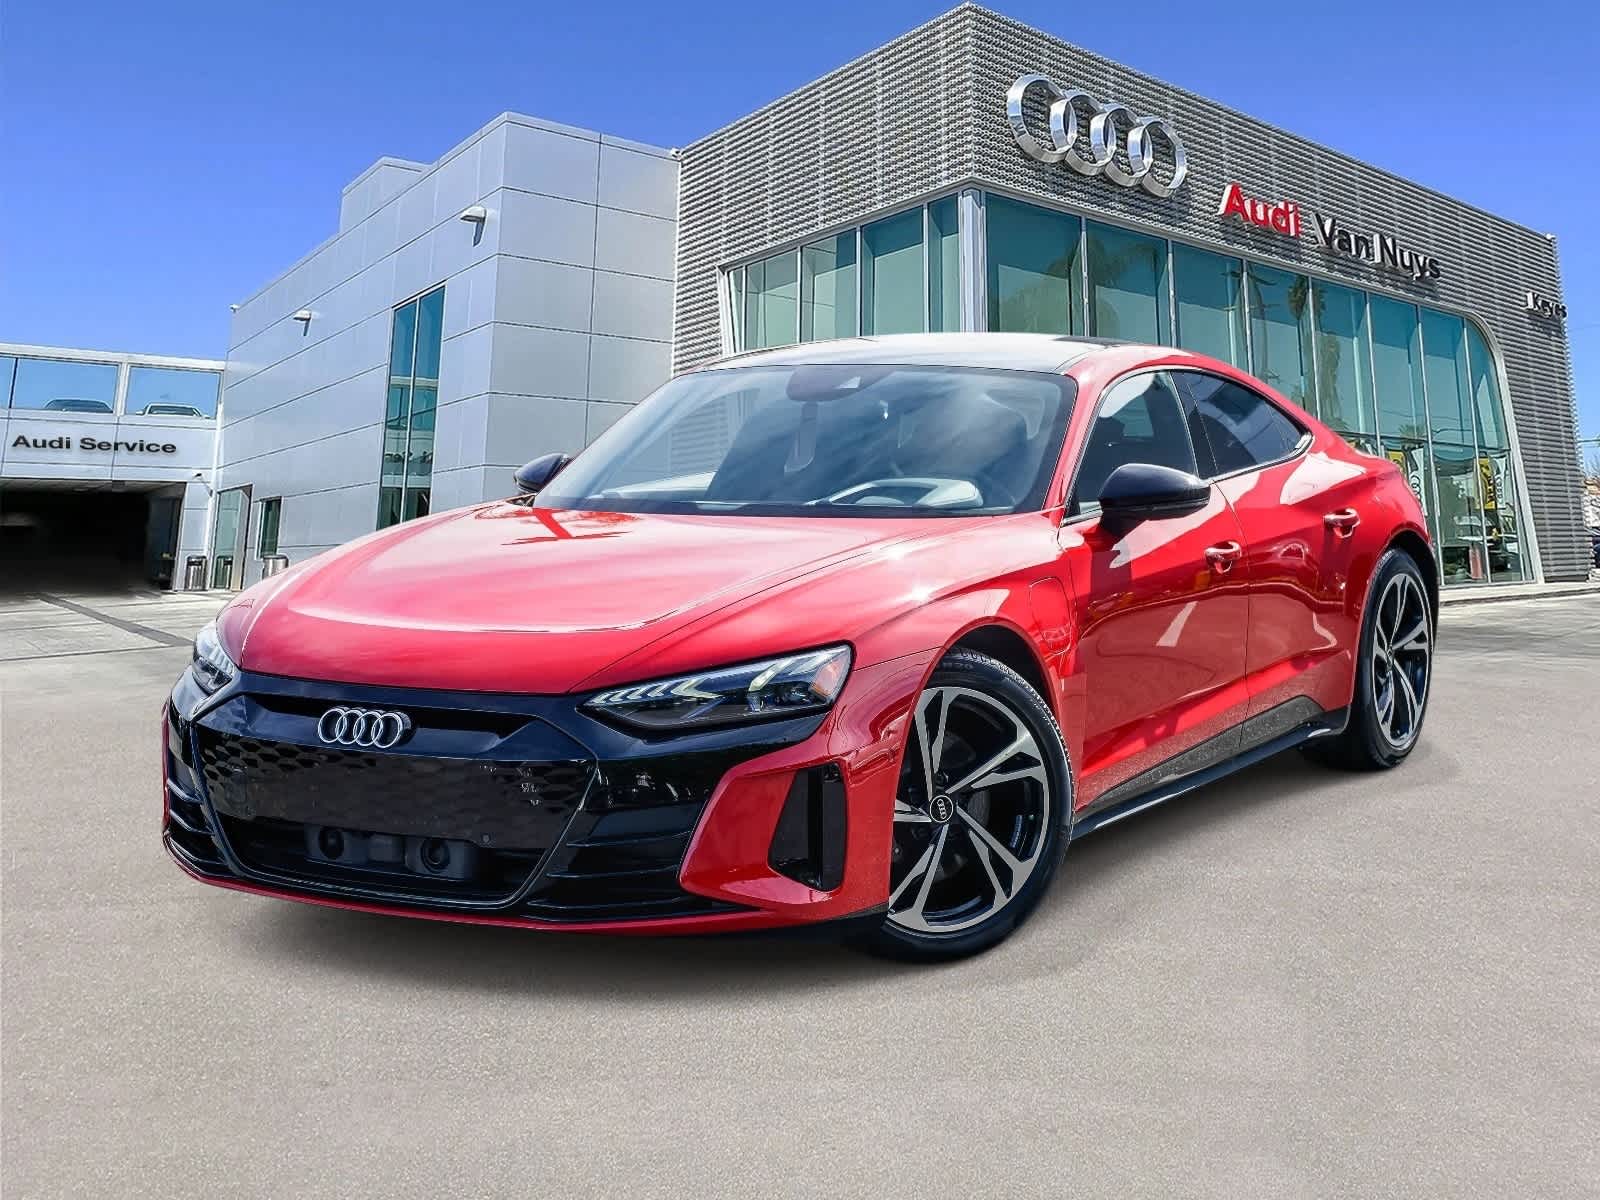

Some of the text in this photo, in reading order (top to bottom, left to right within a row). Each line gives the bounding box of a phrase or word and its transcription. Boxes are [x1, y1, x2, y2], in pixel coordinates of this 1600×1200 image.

[1217, 181, 1441, 281] Audi Van Nuys
[1526, 292, 1567, 318] Keyes
[12, 435, 177, 453] Audi Service
